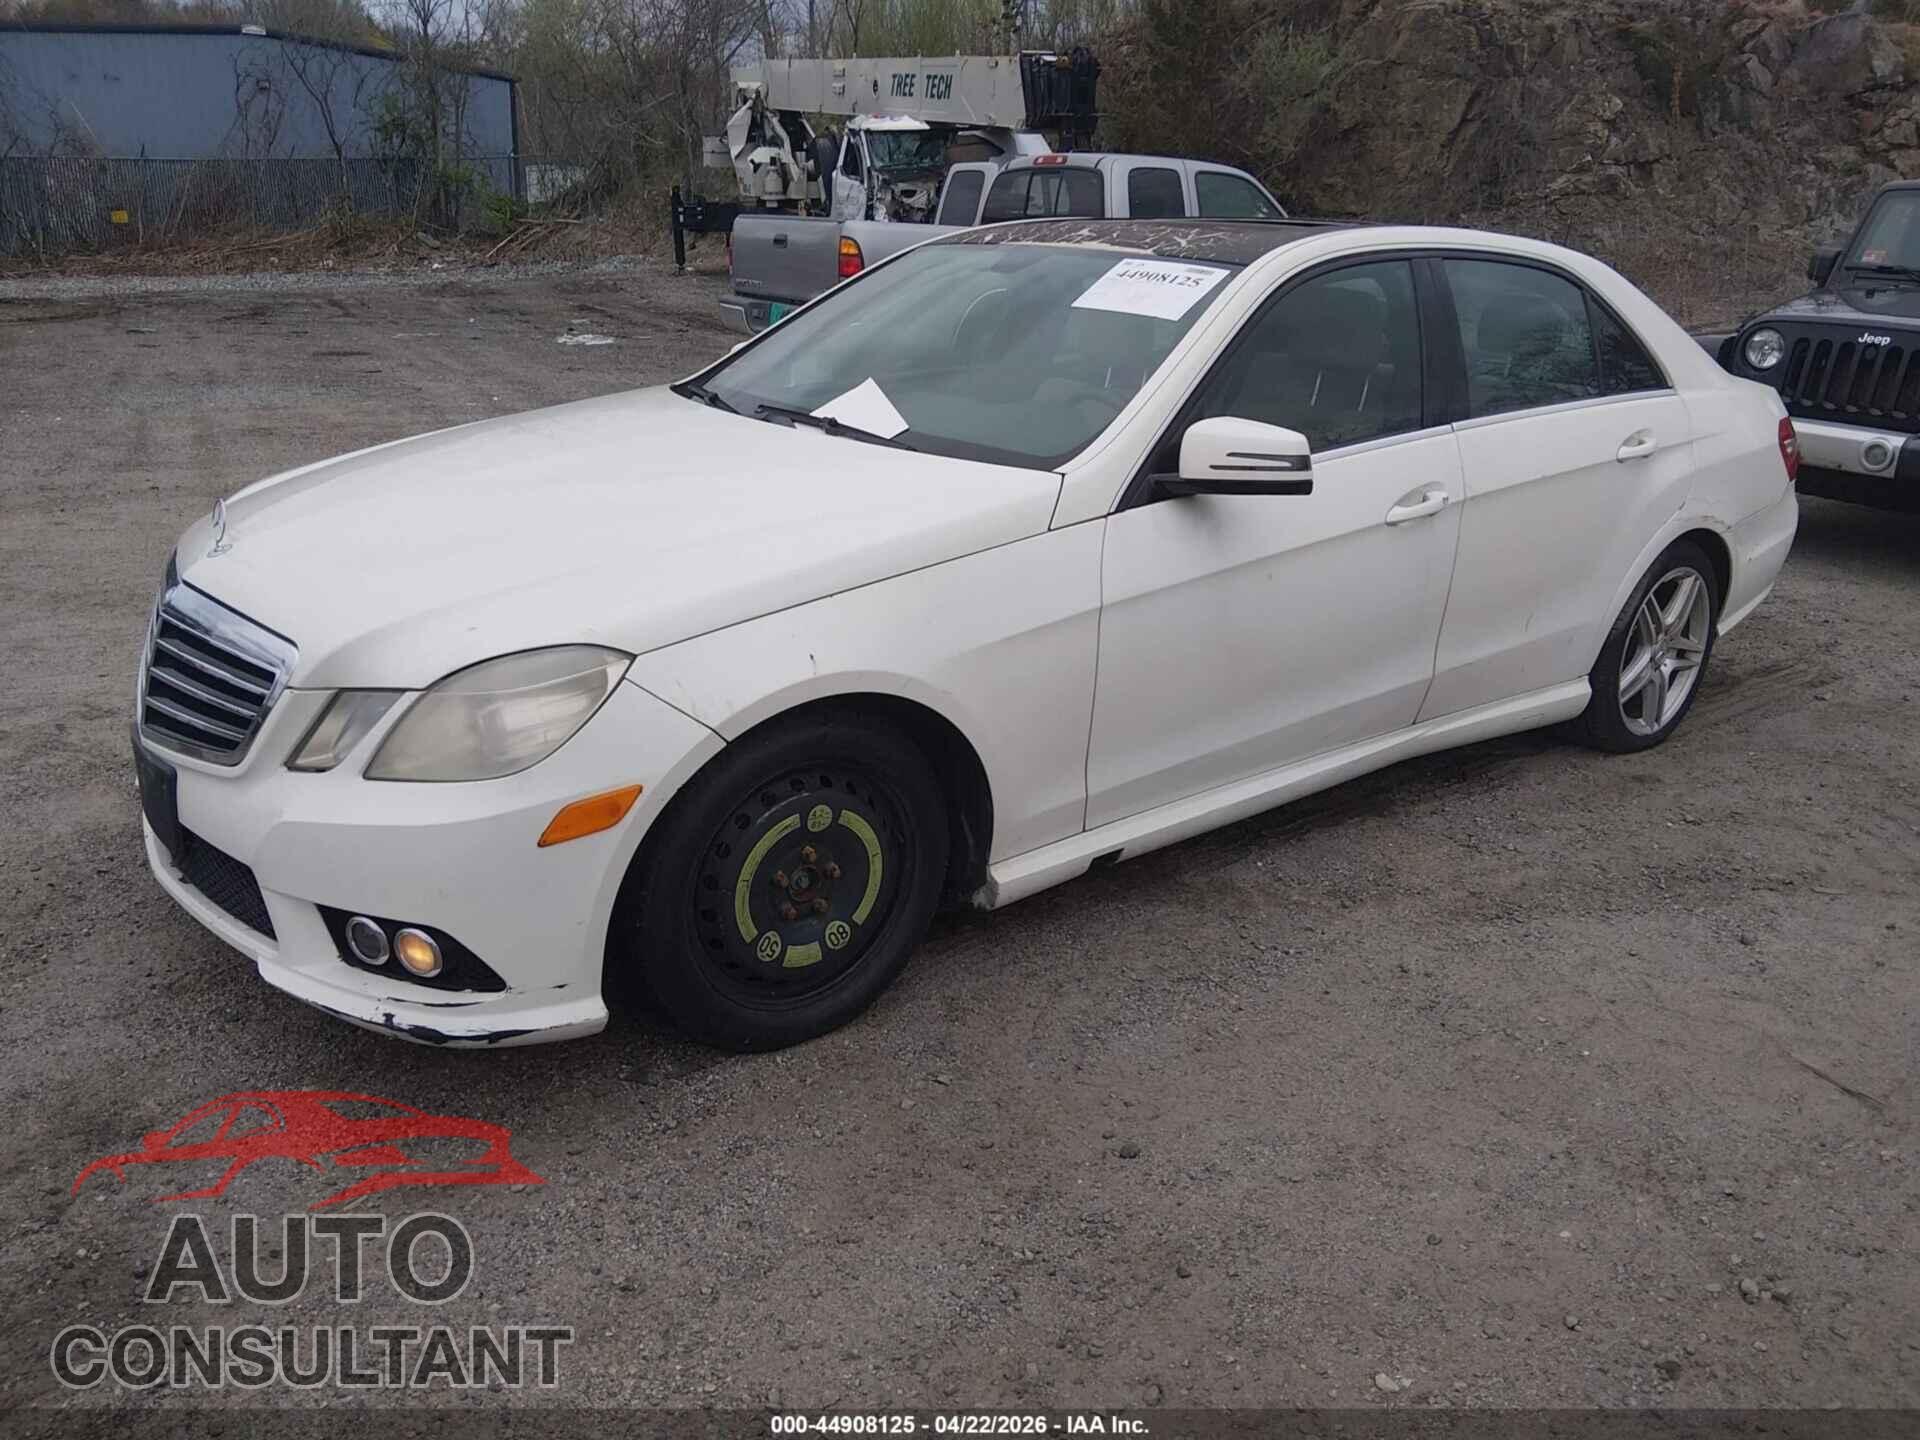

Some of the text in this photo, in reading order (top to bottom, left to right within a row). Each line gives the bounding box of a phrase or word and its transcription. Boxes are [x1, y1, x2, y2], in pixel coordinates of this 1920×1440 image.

[890, 73, 953, 100] TREE TECH
[1117, 268, 1205, 289] 44908125
[1858, 332, 1891, 346] Jeep
[760, 935, 780, 959] 50
[827, 923, 849, 947] 80
